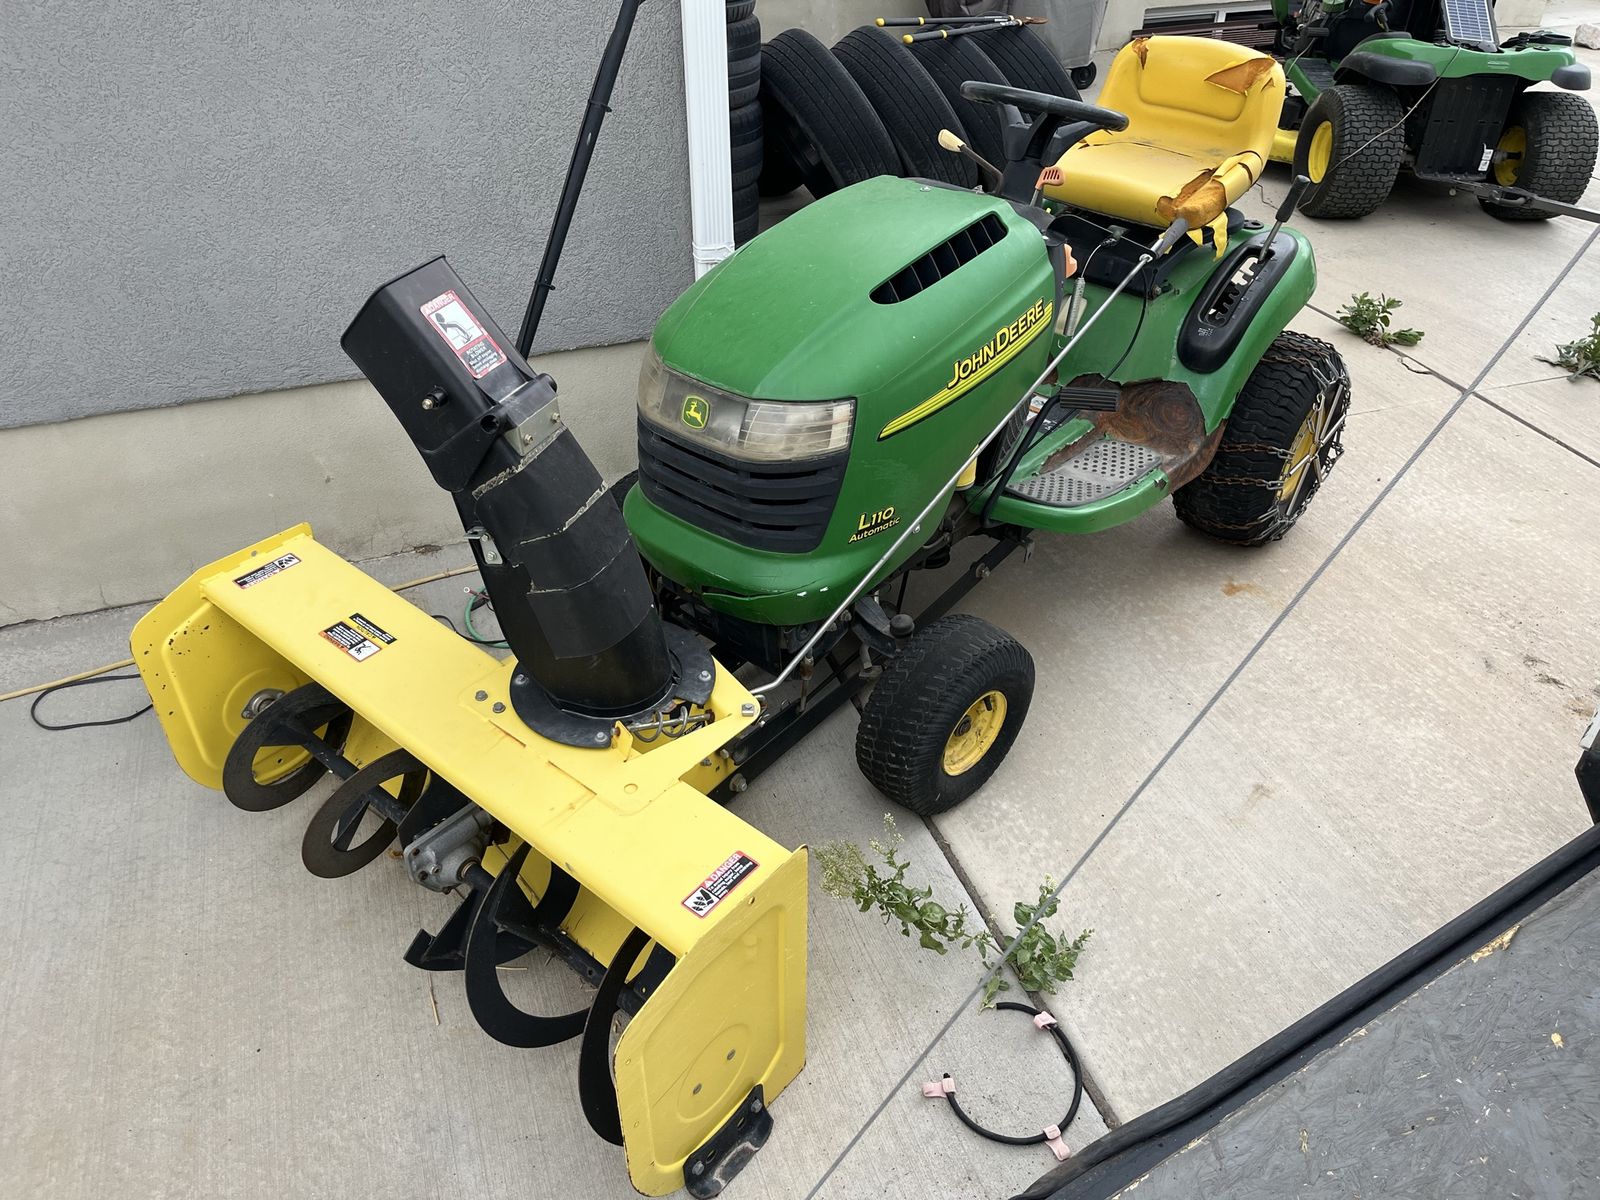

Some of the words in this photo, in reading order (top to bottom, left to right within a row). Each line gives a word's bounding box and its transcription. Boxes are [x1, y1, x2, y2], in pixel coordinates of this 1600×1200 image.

[947, 340, 995, 389] JOHN
[995, 297, 1044, 352] DEERE
[848, 517, 900, 544] Automatic
[858, 506, 895, 531] L110
[711, 853, 741, 879] DANGER
